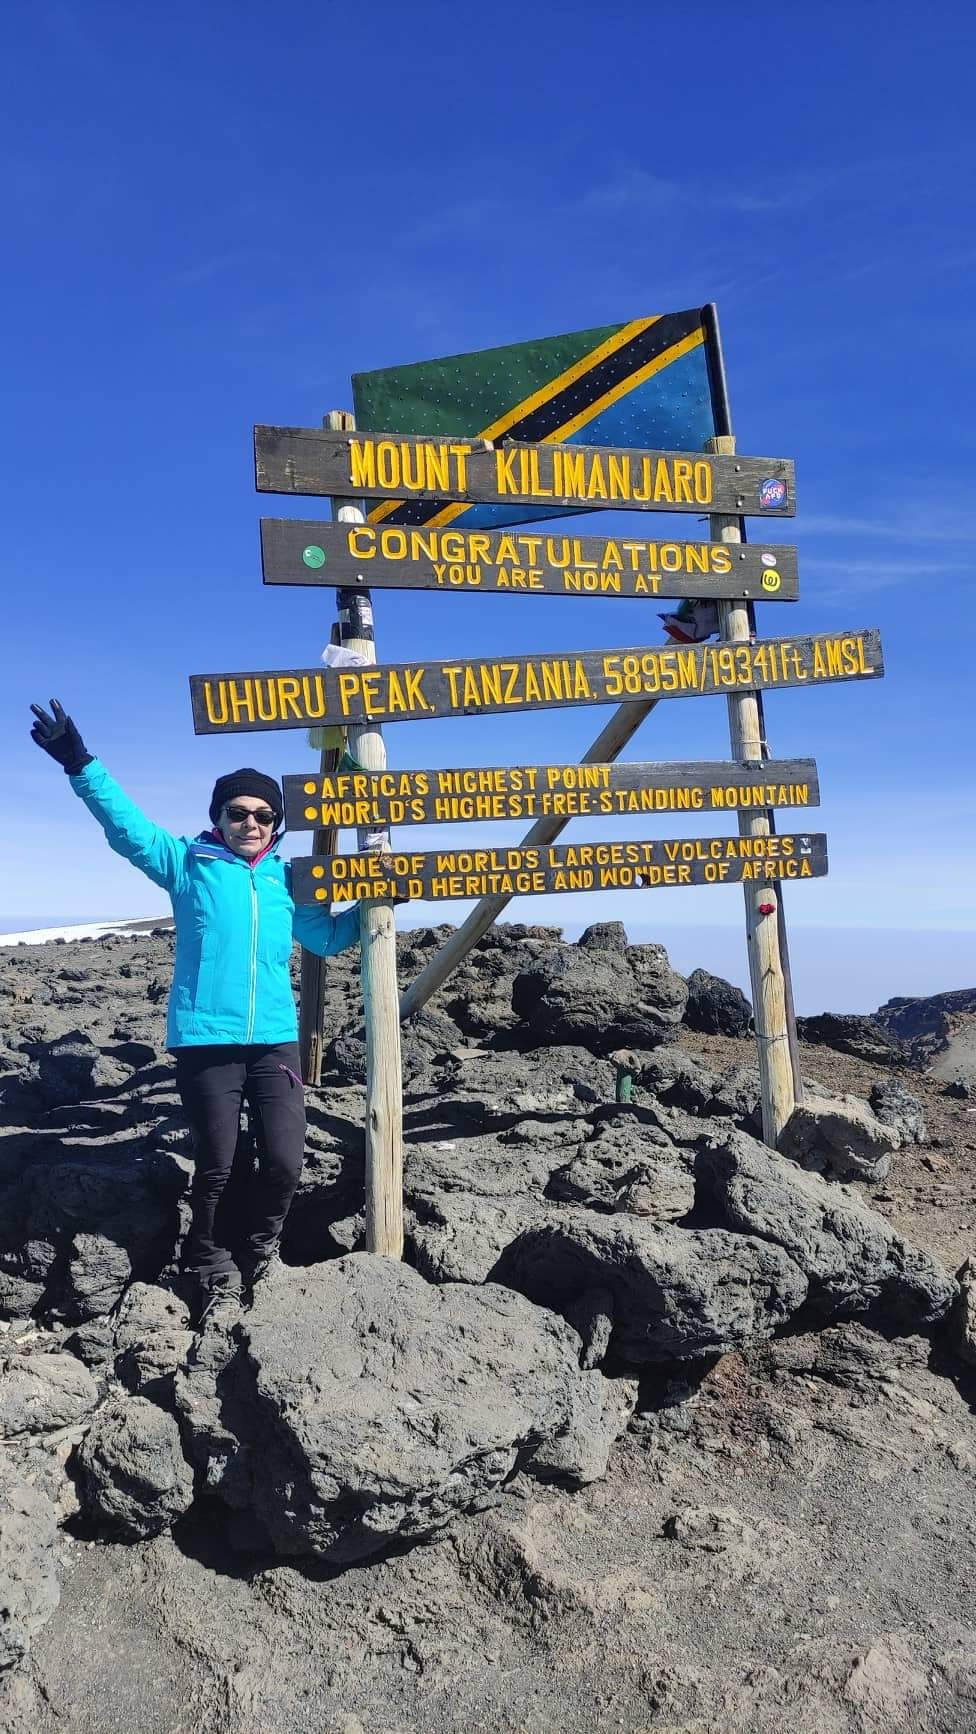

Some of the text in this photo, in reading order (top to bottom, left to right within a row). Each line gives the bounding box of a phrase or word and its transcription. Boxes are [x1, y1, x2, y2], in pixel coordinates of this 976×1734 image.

[351, 440, 713, 504] MOUNT KILIMANJARO
[347, 527, 733, 574] CONGRATULATIONS
[433, 563, 663, 593] YOU ARE NOW AT
[204, 675, 326, 725] UHURU
[339, 668, 436, 716] PEAK,
[442, 660, 598, 708] TANZANIA,
[812, 637, 874, 678] AMSL
[438, 769, 537, 794] HIGHEST
[547, 767, 612, 790] POINT
[321, 799, 427, 826] WORLD'S
[434, 793, 536, 820] HIGHEST
[711, 784, 809, 808] MOUNTAIN
[331, 837, 795, 879] ONE OF WORLD'S LARGEST VOLCANOES
[332, 878, 424, 902] WORLD
[431, 872, 546, 897] HERITAGE
[554, 869, 594, 890] AND
[704, 862, 731, 881] OF
[742, 858, 813, 881] AFRICA
